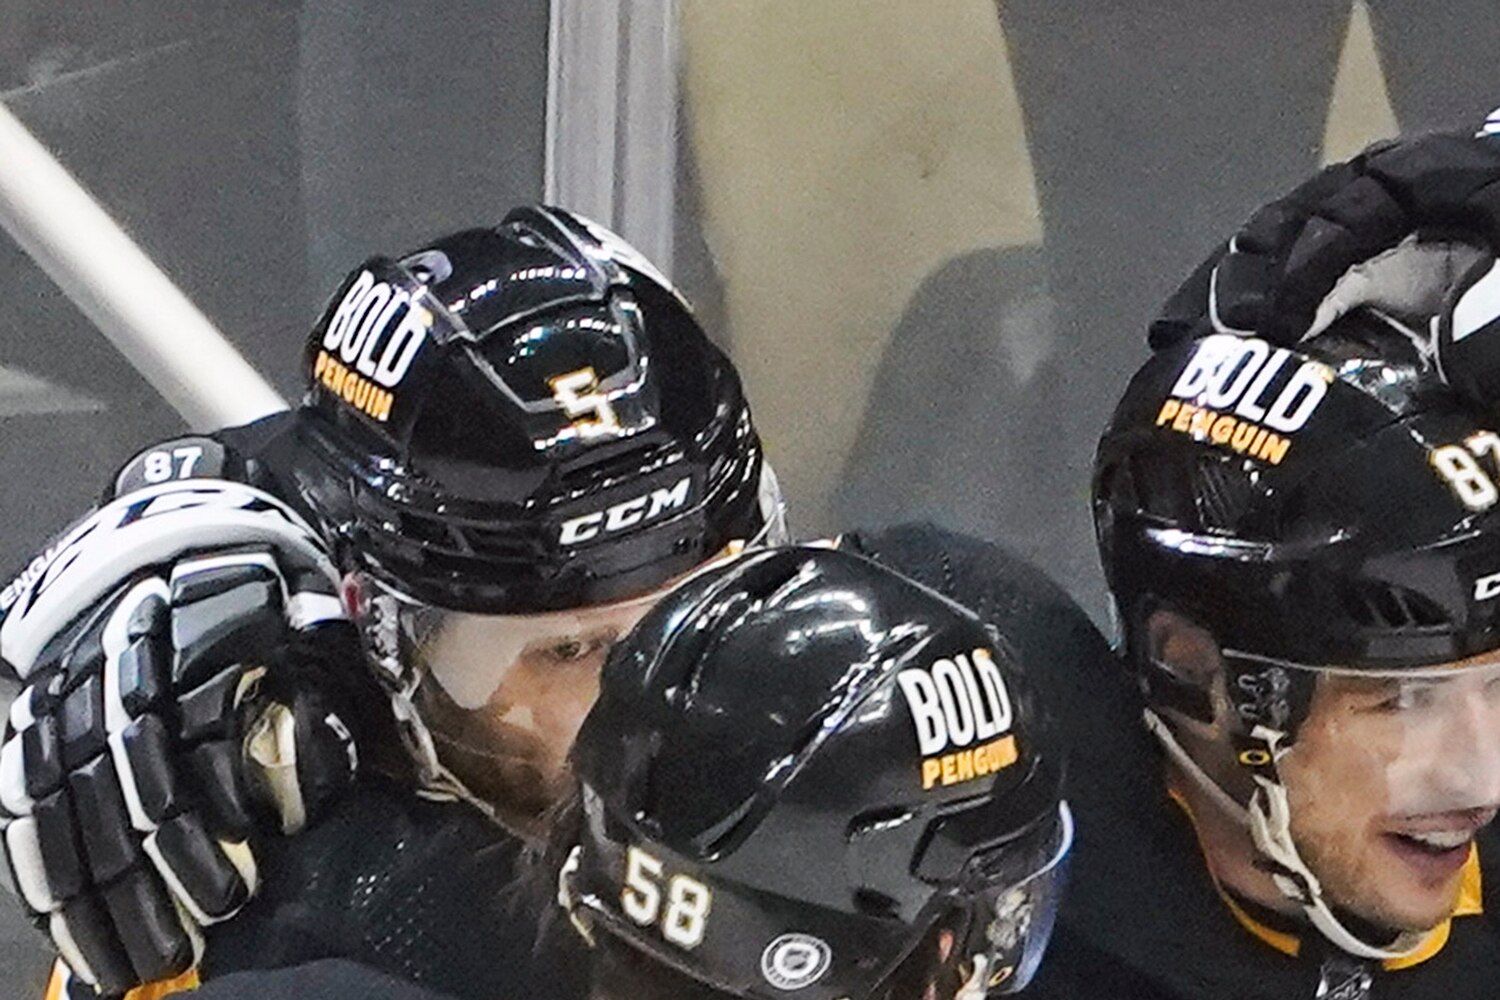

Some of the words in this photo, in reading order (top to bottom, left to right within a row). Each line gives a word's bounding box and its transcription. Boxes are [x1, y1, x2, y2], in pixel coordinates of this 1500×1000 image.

[323, 268, 429, 388] BOLD
[314, 349, 394, 422] PENGUIN
[549, 366, 620, 440] 5
[1171, 333, 1328, 433] BOLD
[143, 446, 202, 483] 87
[1156, 399, 1292, 466] PENGUIN
[559, 477, 691, 546] CCM
[897, 648, 1013, 756] BOLD
[922, 734, 1019, 790] PENGUIN
[621, 844, 712, 950] 58
